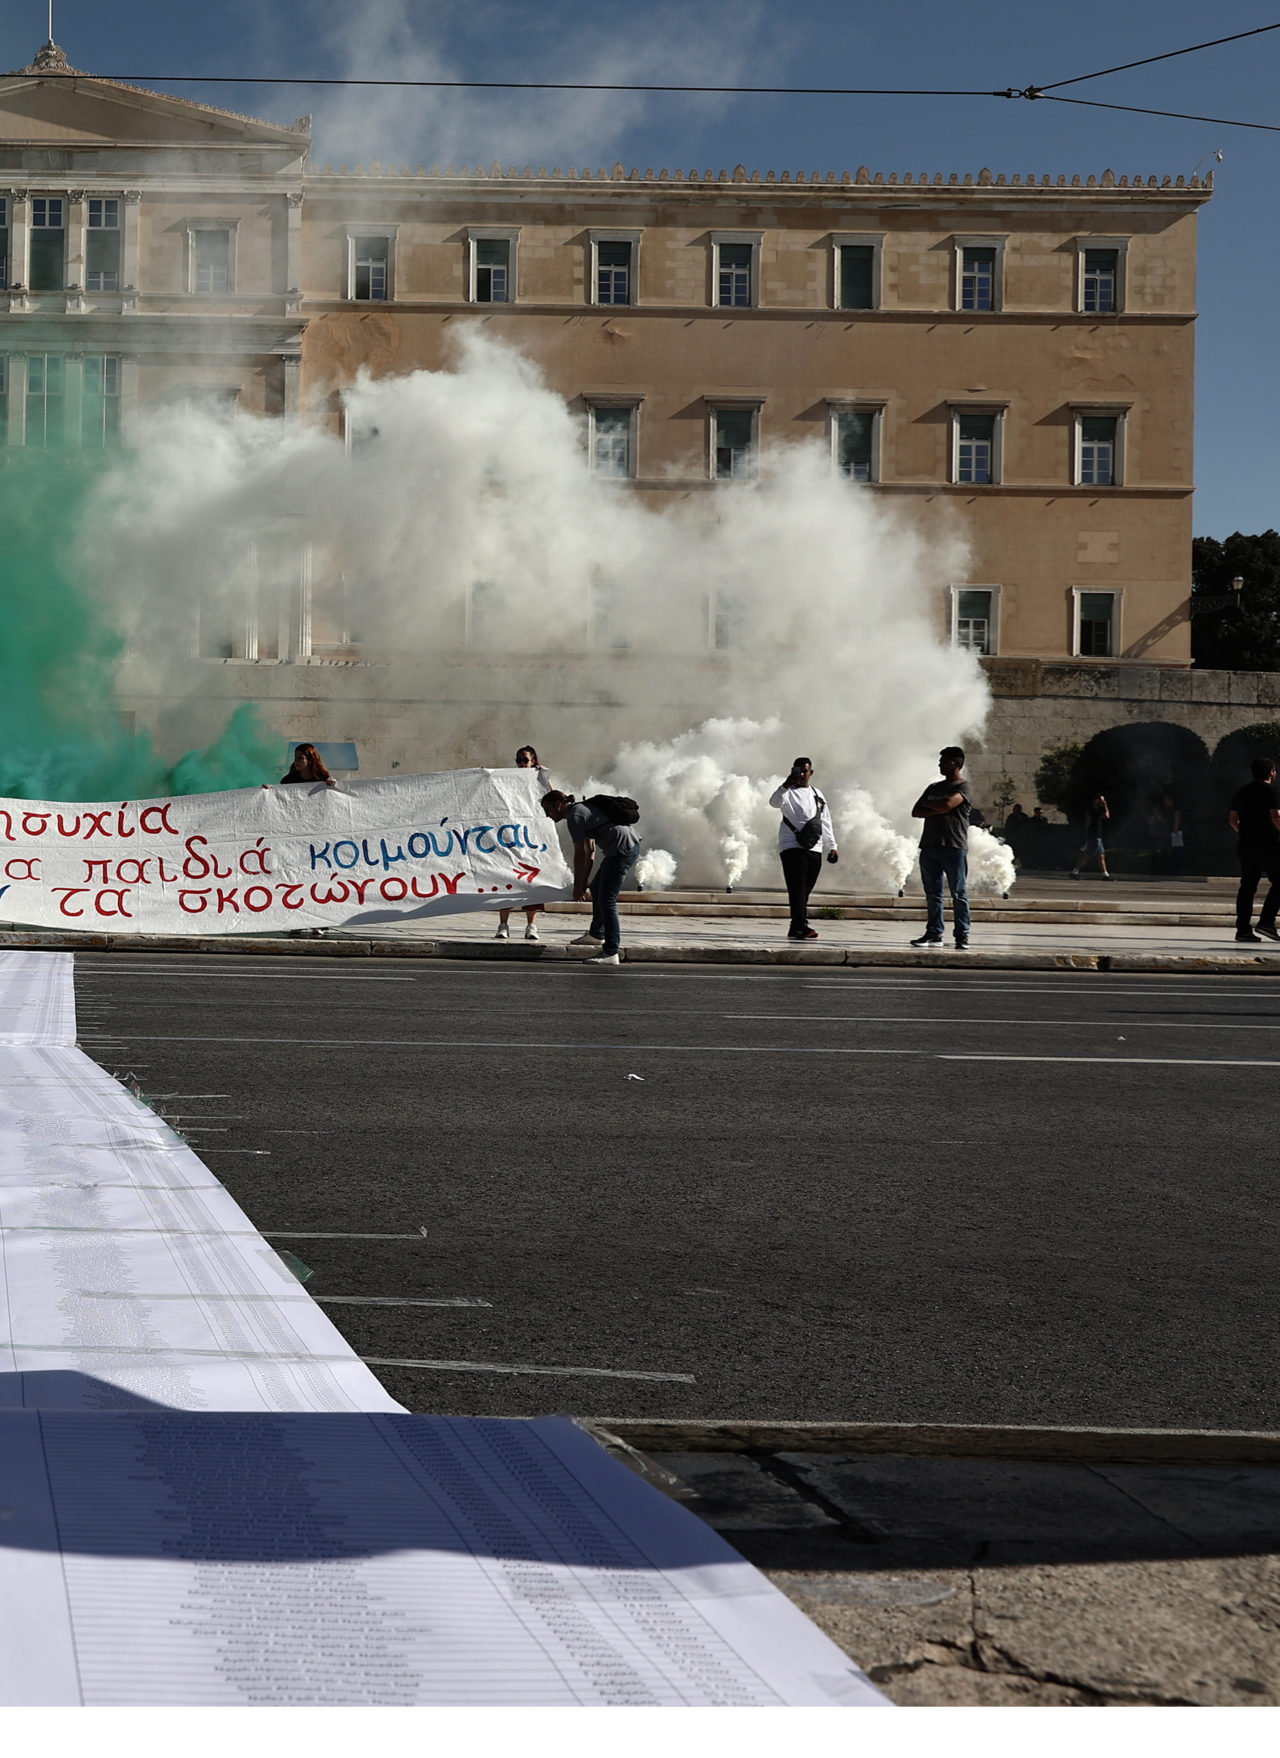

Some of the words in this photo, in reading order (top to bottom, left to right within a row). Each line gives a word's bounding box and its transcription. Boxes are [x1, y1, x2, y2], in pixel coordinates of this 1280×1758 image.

[82, 835, 272, 884] παιδιά
[310, 817, 548, 871] κοιμούνται,
[51, 887, 133, 918] τα
